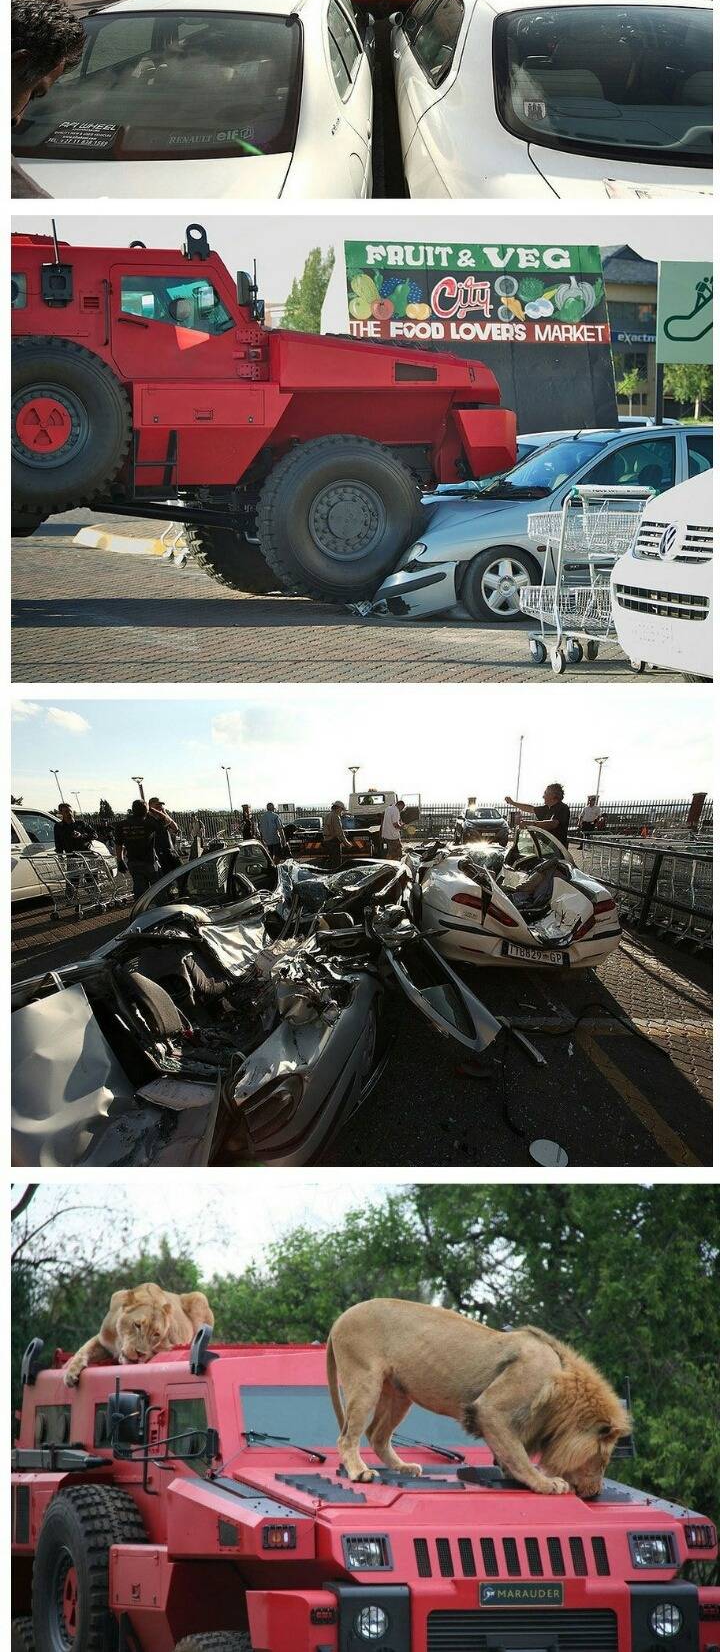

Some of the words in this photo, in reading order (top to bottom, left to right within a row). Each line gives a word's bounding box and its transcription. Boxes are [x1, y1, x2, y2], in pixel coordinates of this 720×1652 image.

[366, 245, 453, 266] FRUIT
[457, 249, 476, 267] &
[483, 247, 571, 269] VEG
[431, 275, 494, 319] City
[349, 320, 382, 338] THE
[390, 321, 445, 340] FOOD
[450, 322, 527, 341] LOVER'S
[534, 324, 606, 342] MARKET
[497, 1588, 561, 1599] MARAUDER
